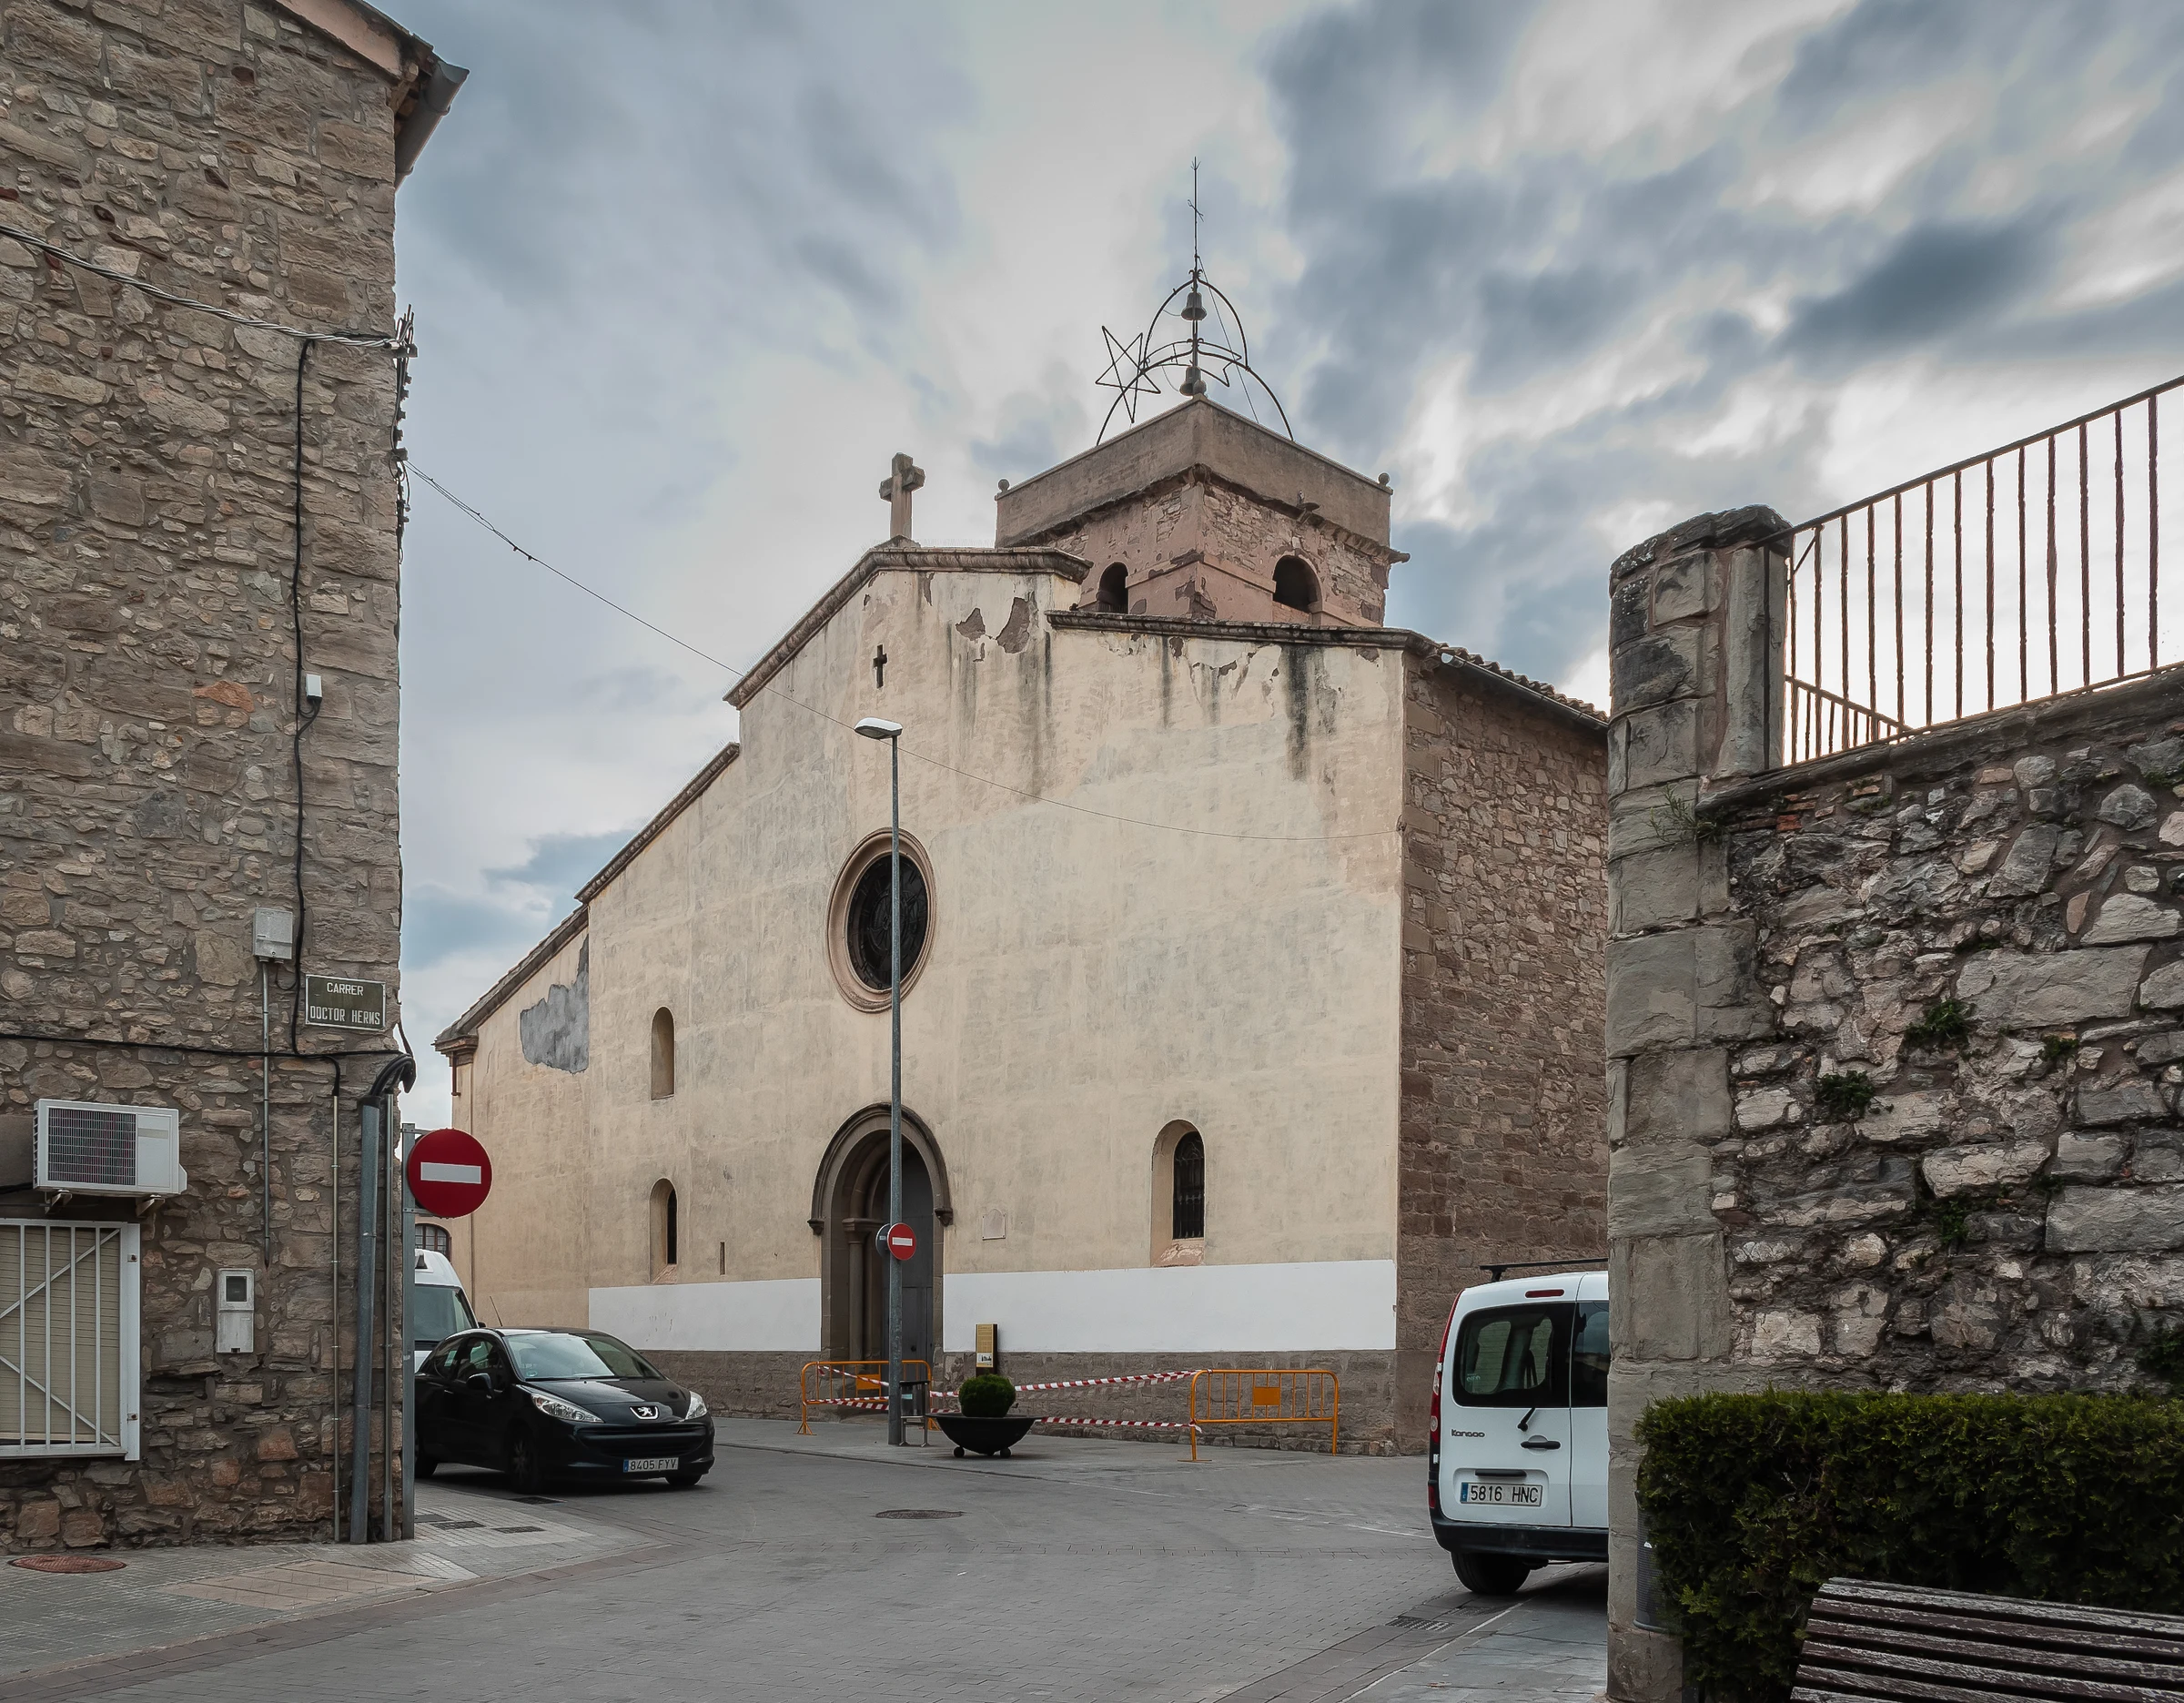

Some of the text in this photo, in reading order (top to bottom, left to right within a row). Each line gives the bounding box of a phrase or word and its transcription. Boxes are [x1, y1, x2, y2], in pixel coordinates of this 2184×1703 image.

[327, 982, 364, 996] CARRER
[309, 1006, 346, 1022] DOCTOR
[630, 1458, 677, 1471] 8405 FYV
[1471, 1485, 1503, 1502] 5816
[1512, 1486, 1539, 1504] HNC
